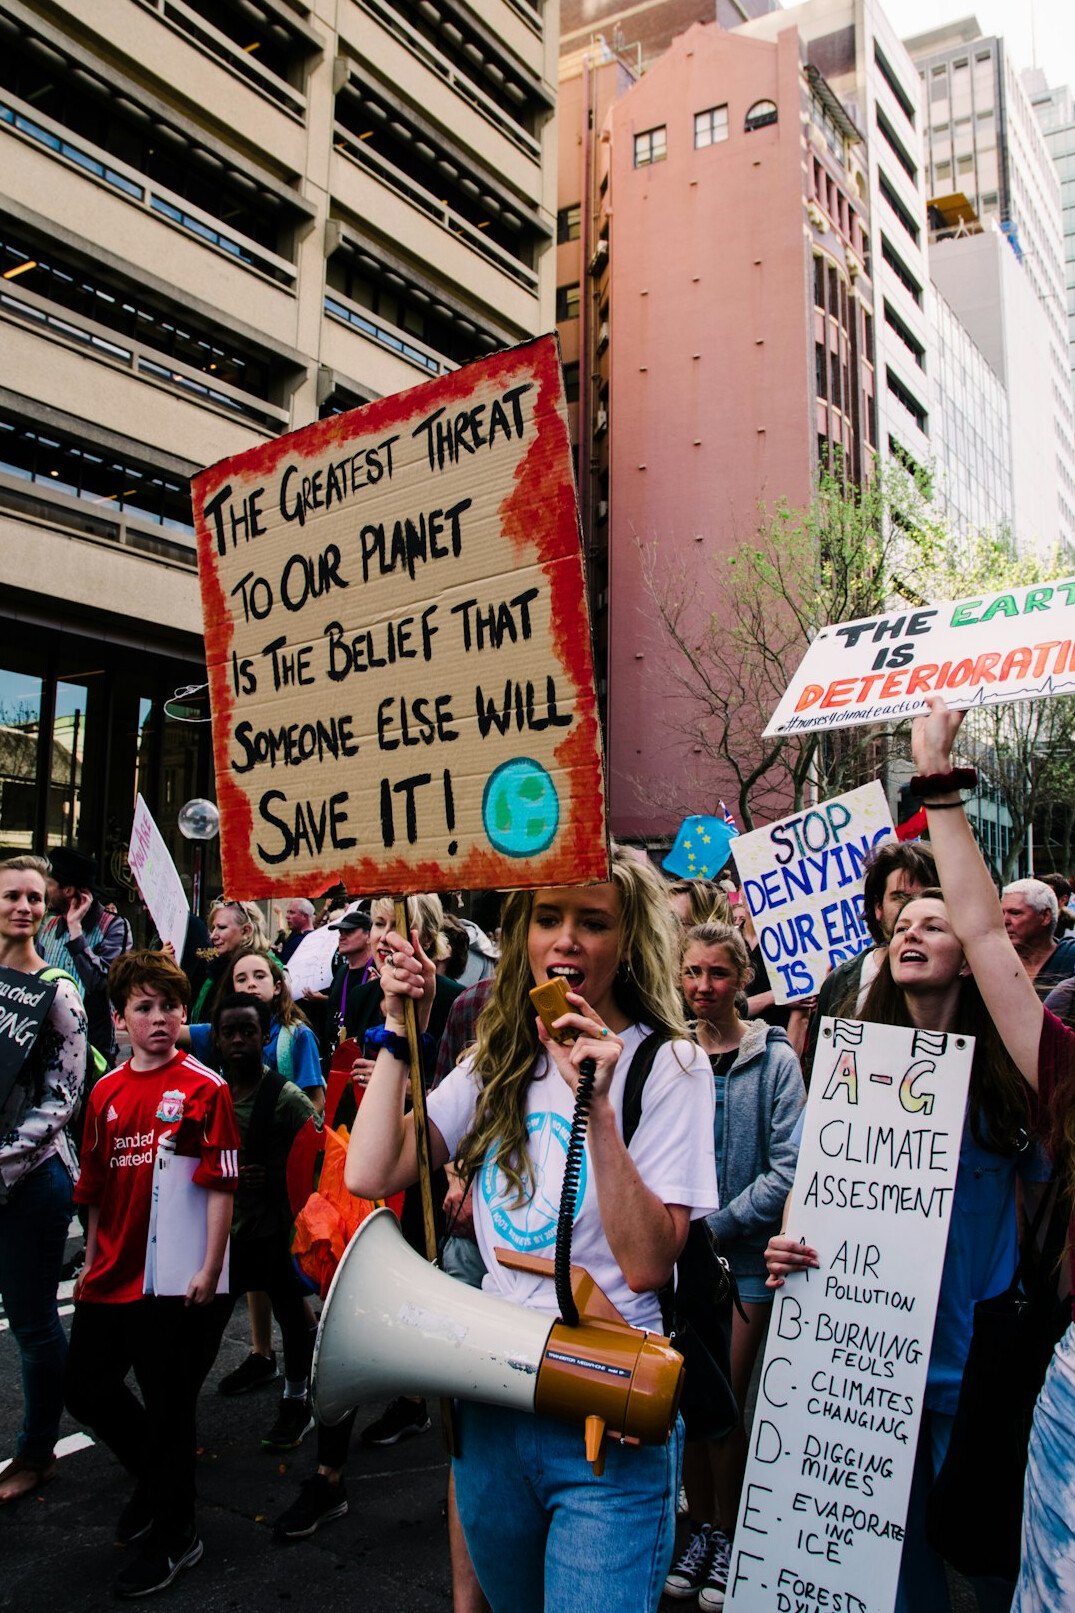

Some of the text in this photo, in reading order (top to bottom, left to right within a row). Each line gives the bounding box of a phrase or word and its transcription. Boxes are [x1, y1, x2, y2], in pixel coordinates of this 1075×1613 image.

[203, 382, 534, 556] THE GREATEST THREAT
[230, 498, 472, 623] TO OUR PLANET
[835, 581, 1075, 648] THE EART
[232, 587, 540, 698] IS THE BELIEF THAT
[871, 642, 915, 671] IS
[793, 639, 1075, 713] DETERIORATI
[230, 675, 573, 774] SOMEONE ELSE WILL
[257, 789, 357, 865] SAVE
[770, 803, 851, 865] STOP
[760, 913, 823, 963] OUR
[0, 981, 46, 1008] ached
[776, 960, 814, 999] IS
[819, 1119, 949, 1172] CLIMATE
[804, 1171, 954, 1218] ASSESMENT
[830, 1240, 880, 1279] AIR
[825, 1276, 915, 1313] POLLUTION
[815, 1313, 923, 1365] BURNING
[831, 1348, 895, 1379] FEULS
[811, 1371, 914, 1416] CLIMATES
[807, 1398, 909, 1445] CHANGING
[801, 1457, 874, 1497] MINES
[803, 1434, 893, 1478] DIGGING
[798, 1529, 841, 1565] ICE
[826, 1523, 853, 1546] ING
